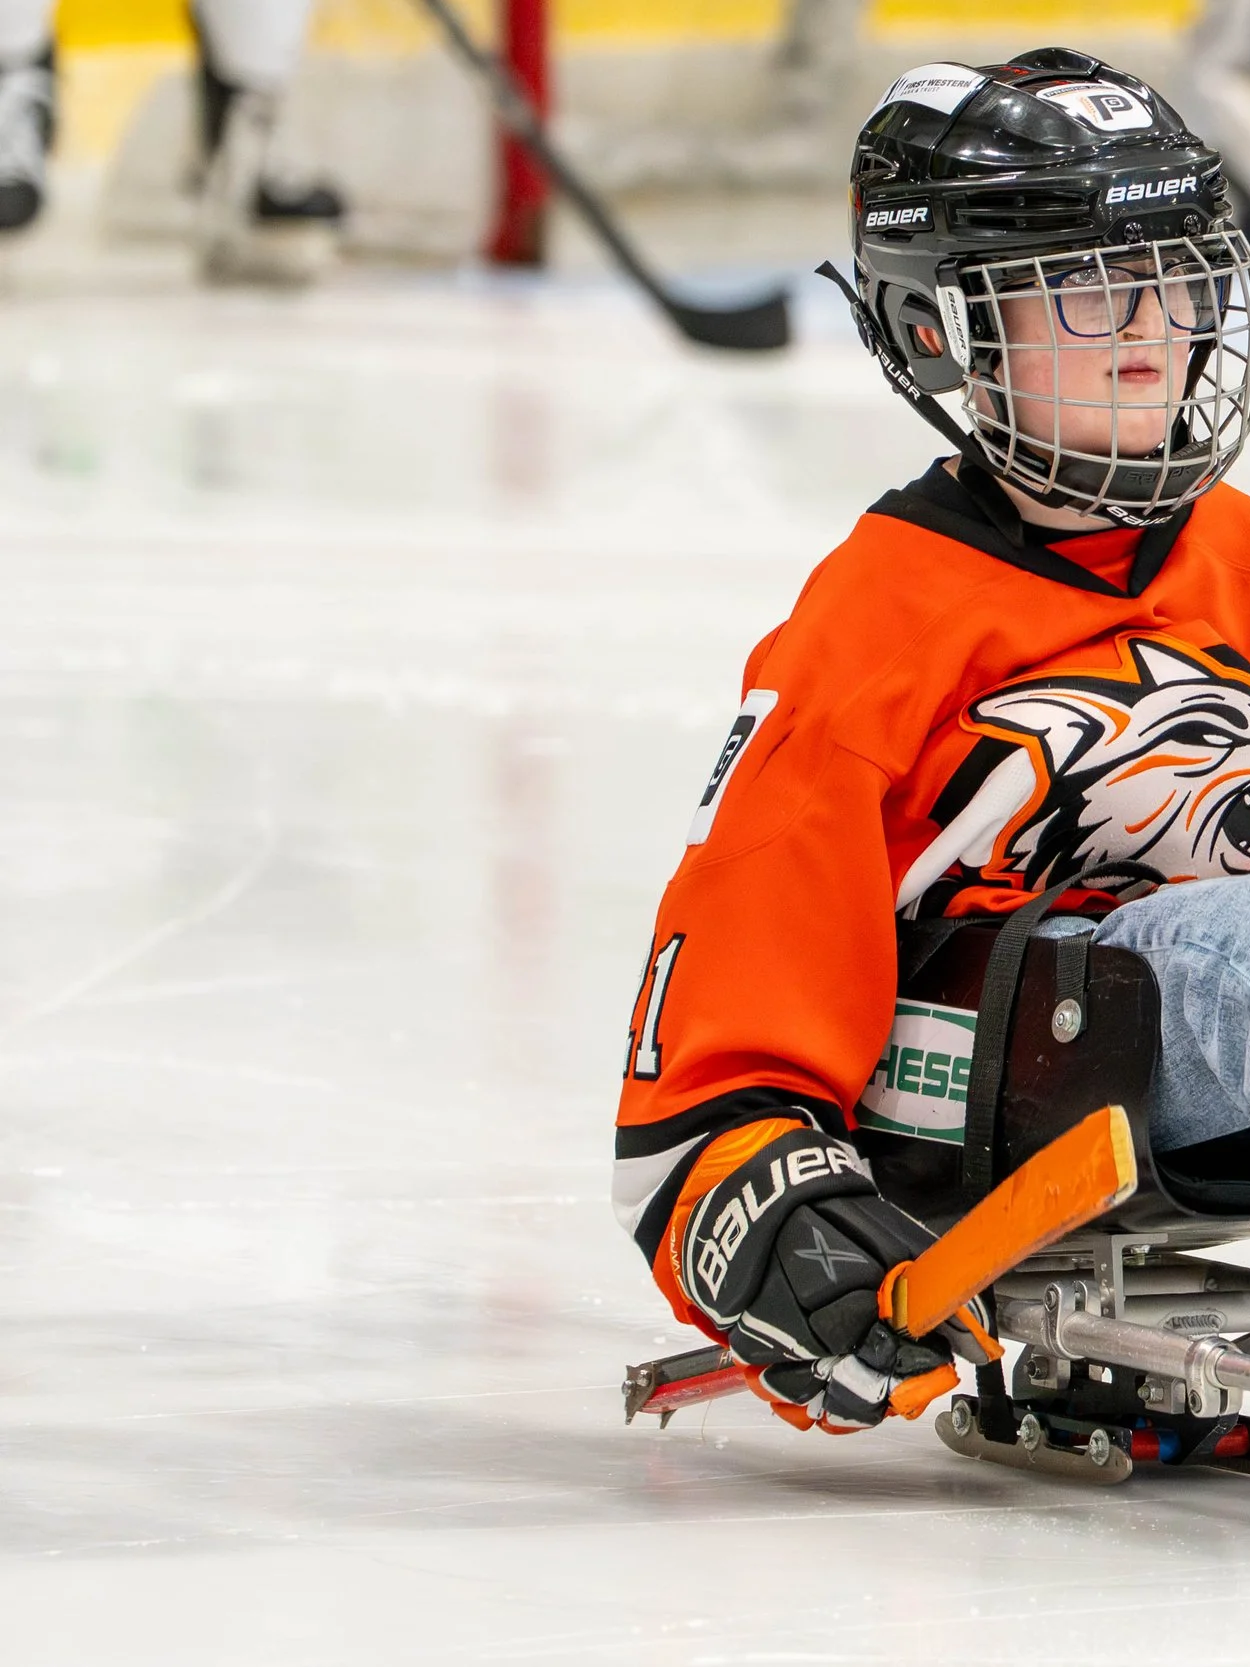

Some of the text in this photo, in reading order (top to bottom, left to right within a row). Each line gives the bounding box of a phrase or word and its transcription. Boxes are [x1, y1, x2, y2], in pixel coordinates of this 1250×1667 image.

[903, 78, 972, 90] FIRST WESTERN
[623, 932, 687, 1081] 1
[866, 1043, 973, 1104] HESS
